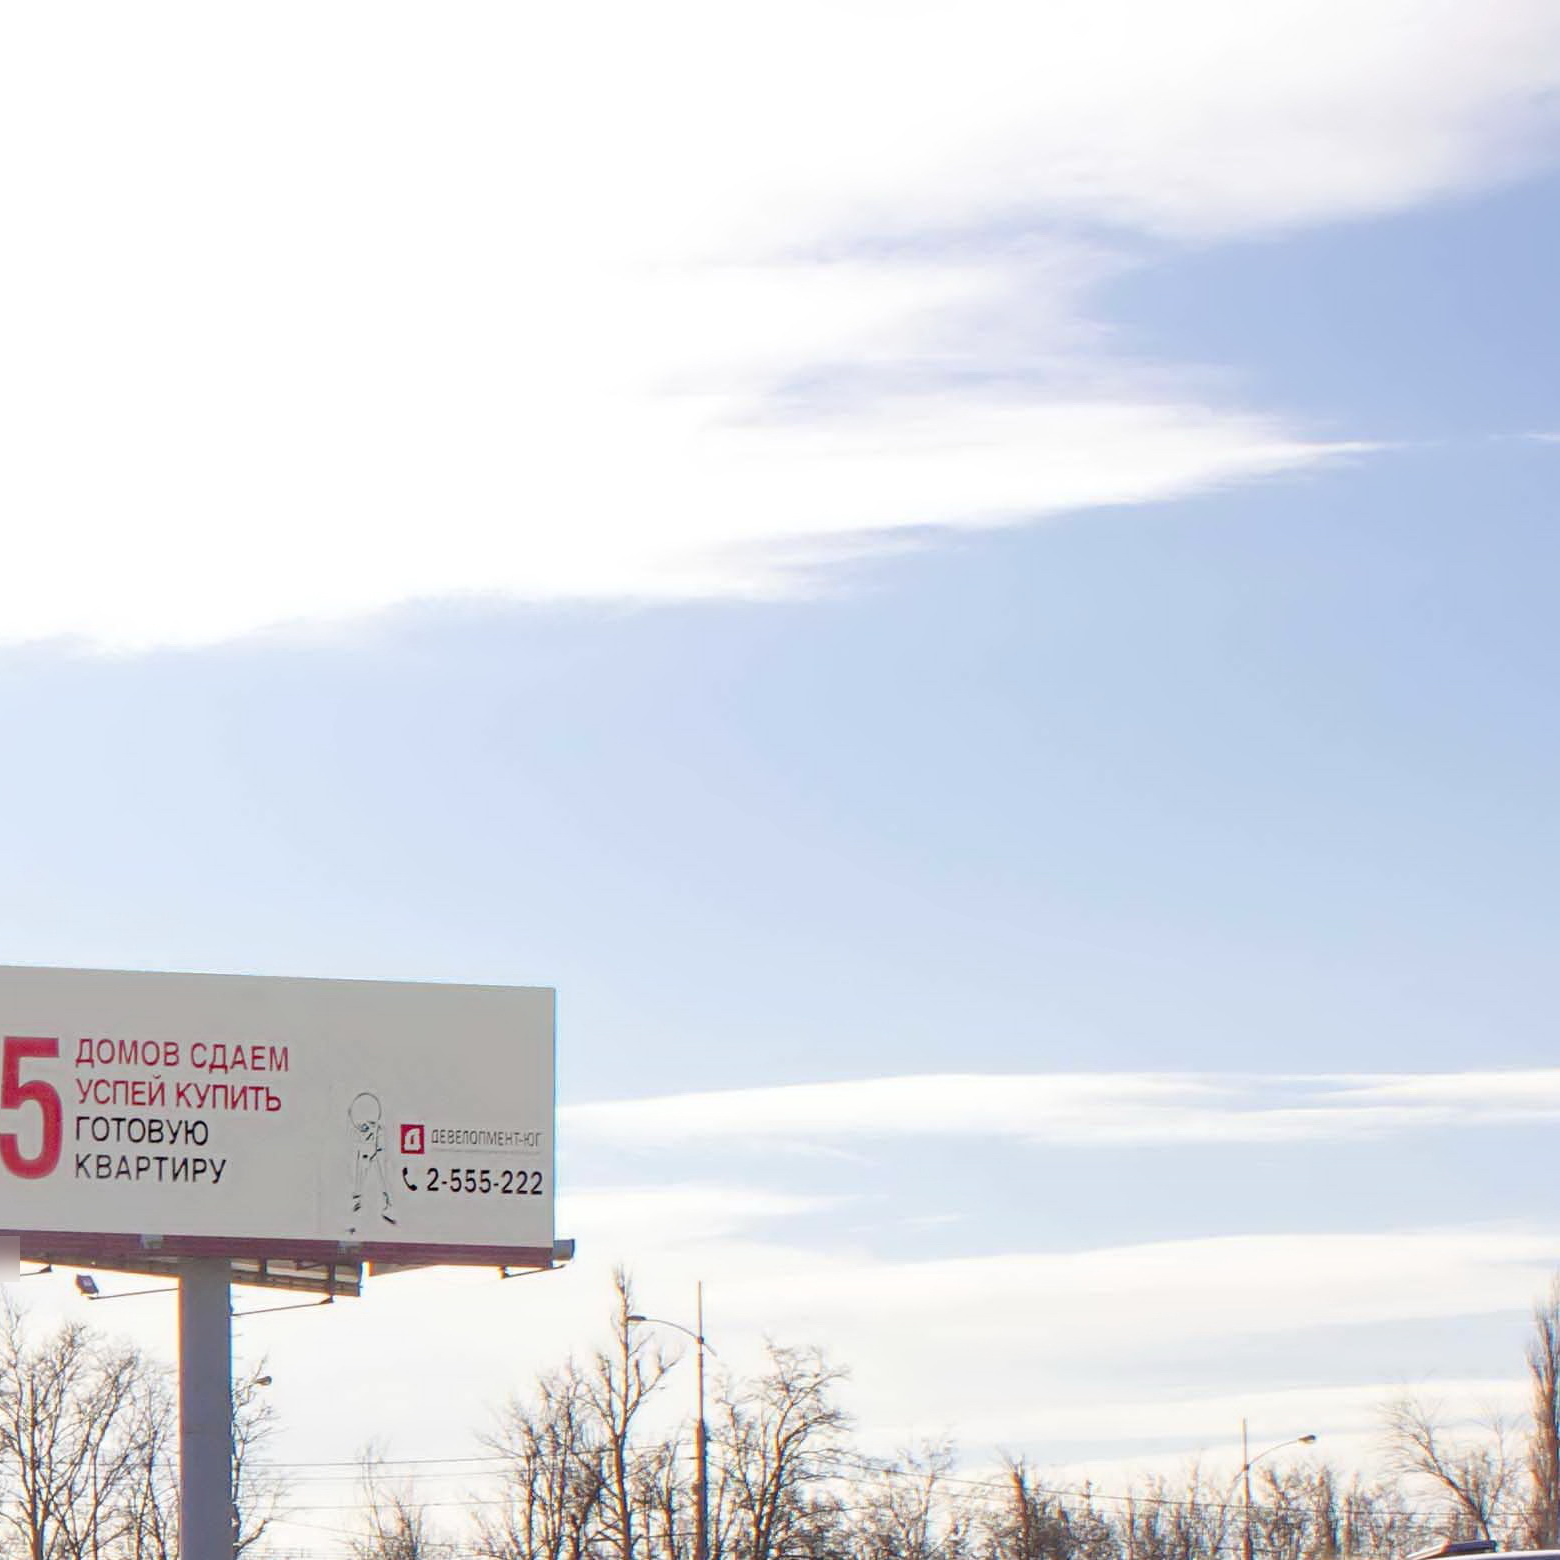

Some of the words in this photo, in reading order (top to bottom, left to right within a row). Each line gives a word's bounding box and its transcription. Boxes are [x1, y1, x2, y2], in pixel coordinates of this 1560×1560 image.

[75, 1038, 180, 1068] ДОМОВ
[190, 1042, 289, 1074] СДАЕМ
[76, 1074, 165, 1107] УСПЕЙ
[176, 1081, 282, 1112] КУПИТЬ
[75, 1116, 208, 1146] ГОТОВУЮ
[431, 1128, 543, 1147] ДЕВЕЛОПМЕНТ-ЮГ
[75, 1153, 227, 1184] КВАРТИРУ
[426, 1167, 543, 1196] 2-555-222
